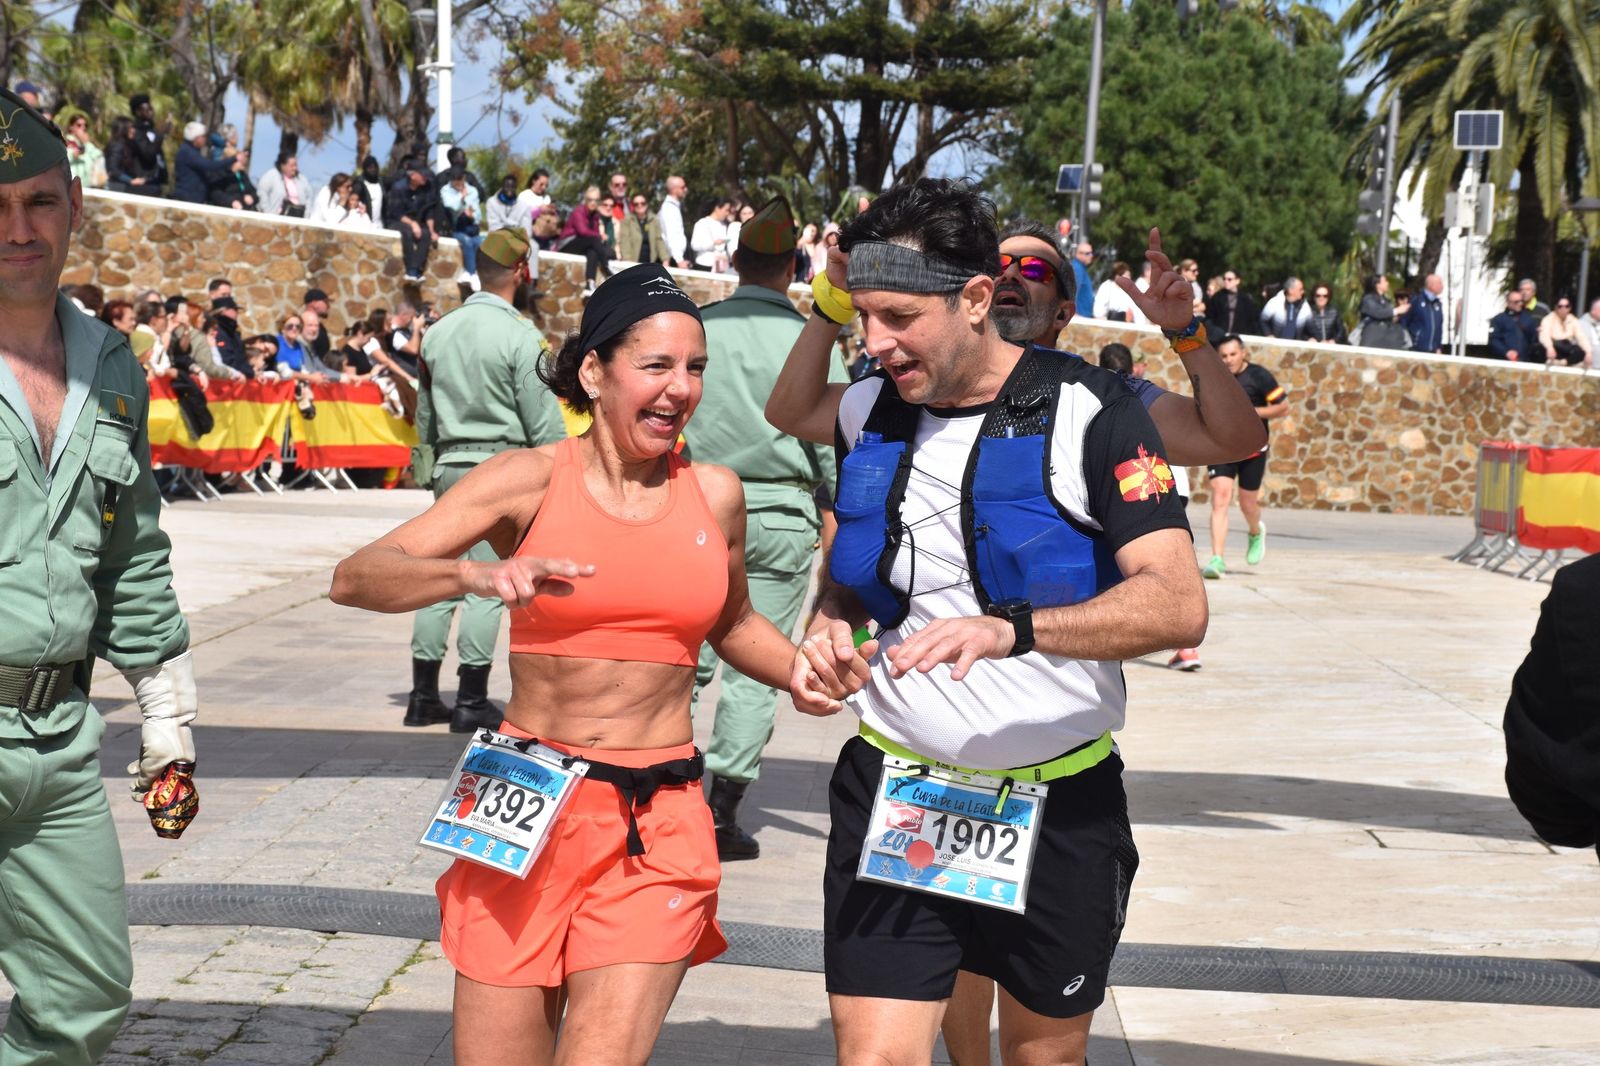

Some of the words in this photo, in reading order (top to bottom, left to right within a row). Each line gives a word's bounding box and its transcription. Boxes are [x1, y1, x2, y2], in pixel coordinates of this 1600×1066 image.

[473, 778, 545, 833] 1392
[932, 814, 1019, 866] 1902
[938, 853, 956, 862] JOSE
